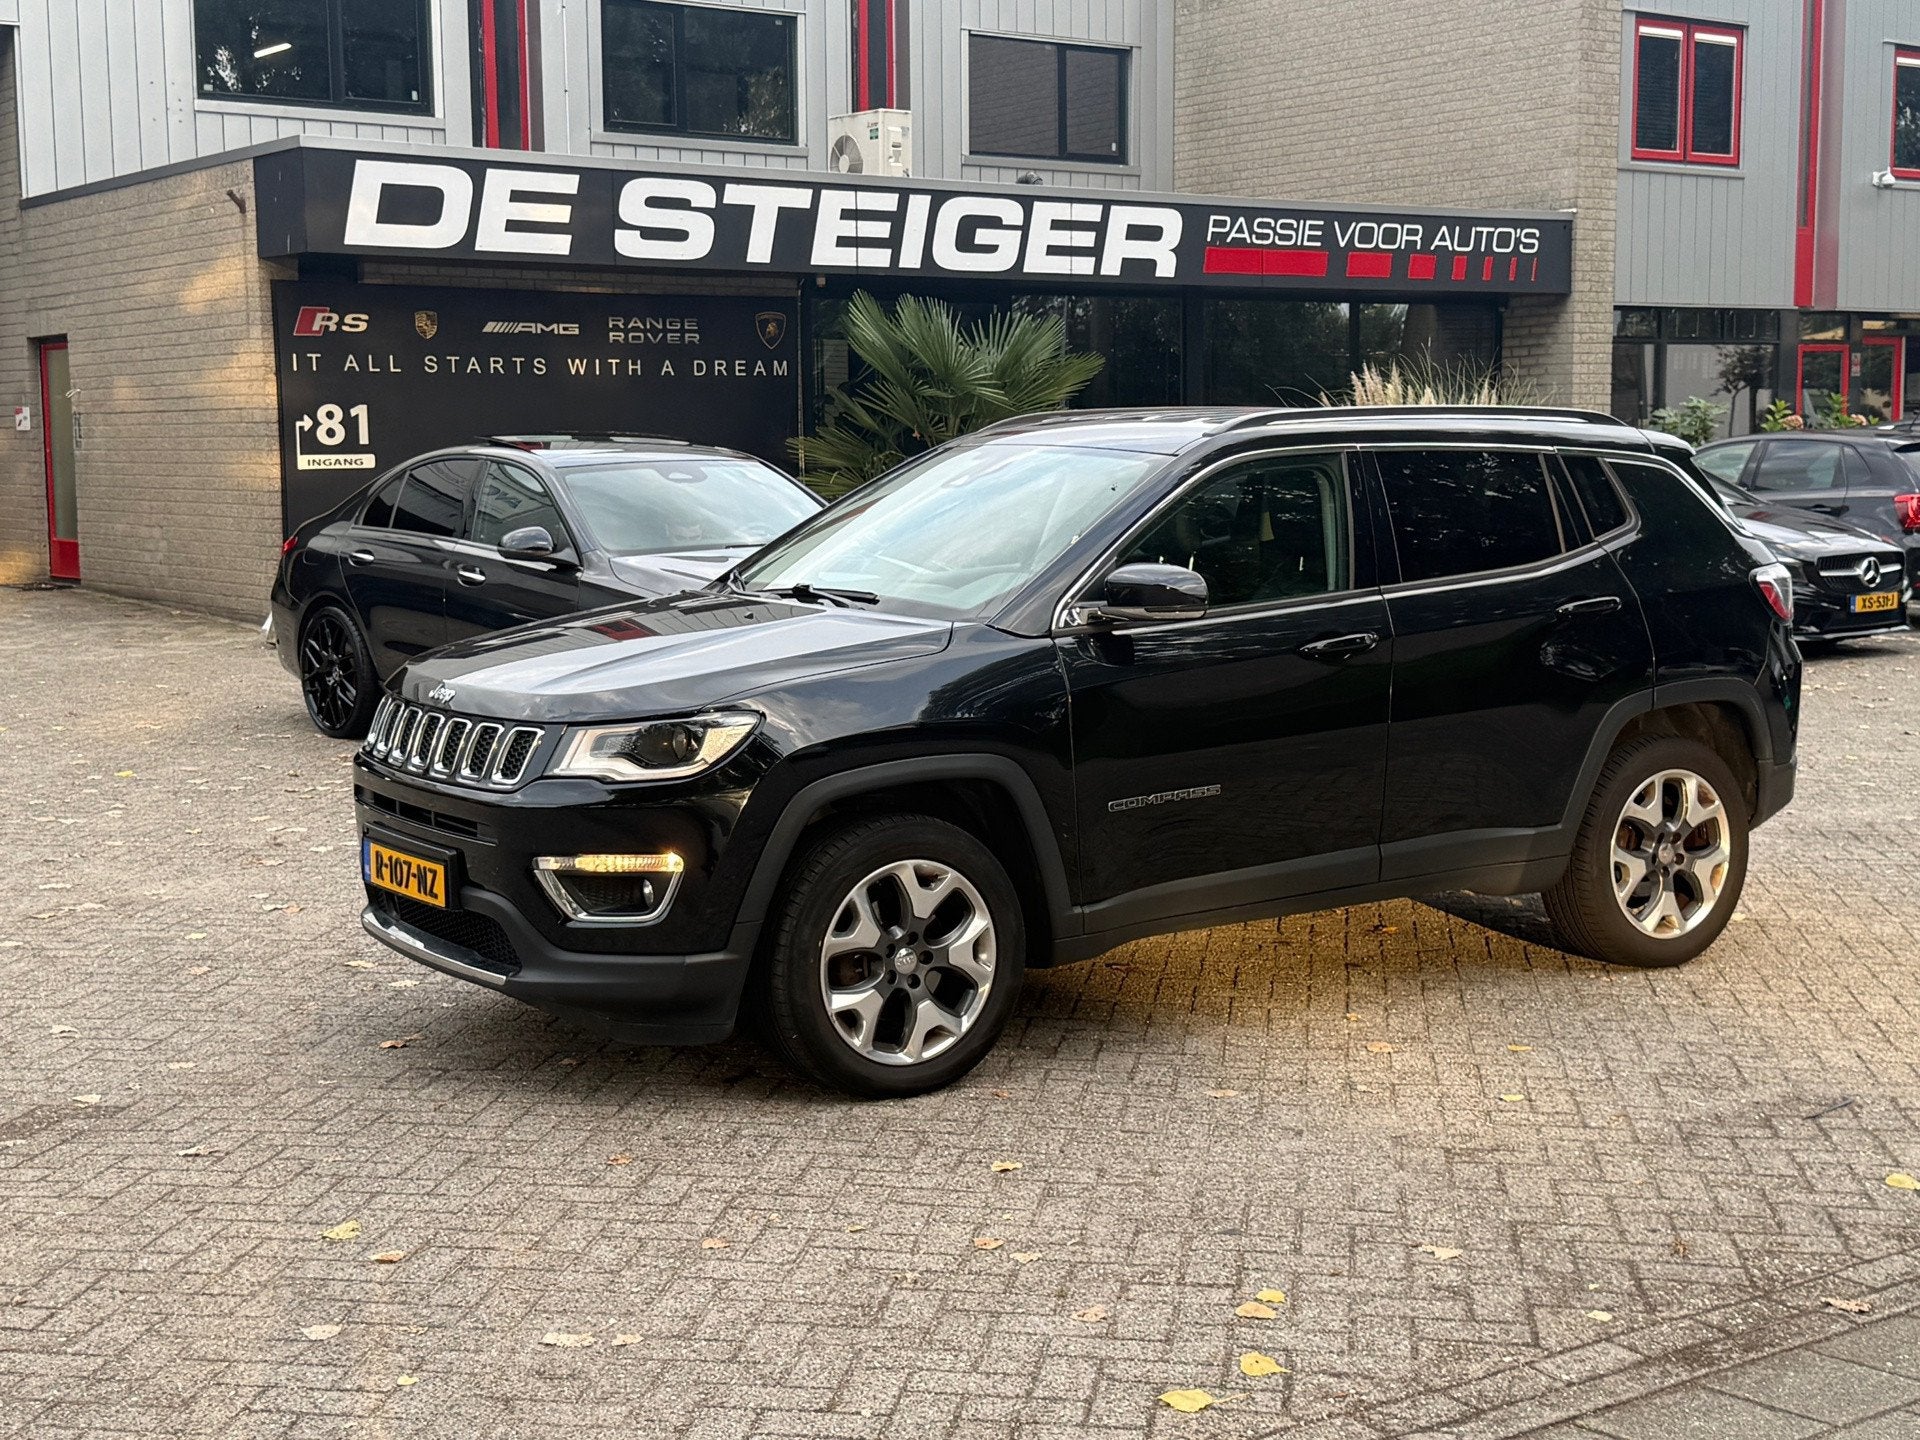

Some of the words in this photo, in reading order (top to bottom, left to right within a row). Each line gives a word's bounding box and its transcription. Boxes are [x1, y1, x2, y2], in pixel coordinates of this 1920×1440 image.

[343, 159, 580, 255] DE
[614, 177, 1183, 278] STEIGER
[1206, 215, 1325, 247] PASSIE
[1334, 220, 1424, 250] VOOR
[1430, 225, 1540, 254] AUTO'S
[312, 312, 370, 333] RS
[516, 322, 580, 335] AMG
[608, 316, 699, 330] RANGE
[608, 332, 700, 344] ROVER
[292, 353, 322, 372] IT
[344, 354, 402, 373] ALL
[424, 355, 547, 375] STARTS
[567, 358, 642, 376] WITH
[660, 360, 675, 376] A
[693, 360, 788, 376] DREAM
[316, 403, 370, 446] 81
[307, 457, 365, 467] INGANG
[428, 683, 456, 703] Jeep
[1108, 784, 1221, 812] COMPASS
[375, 849, 439, 900] R-107-NZ
